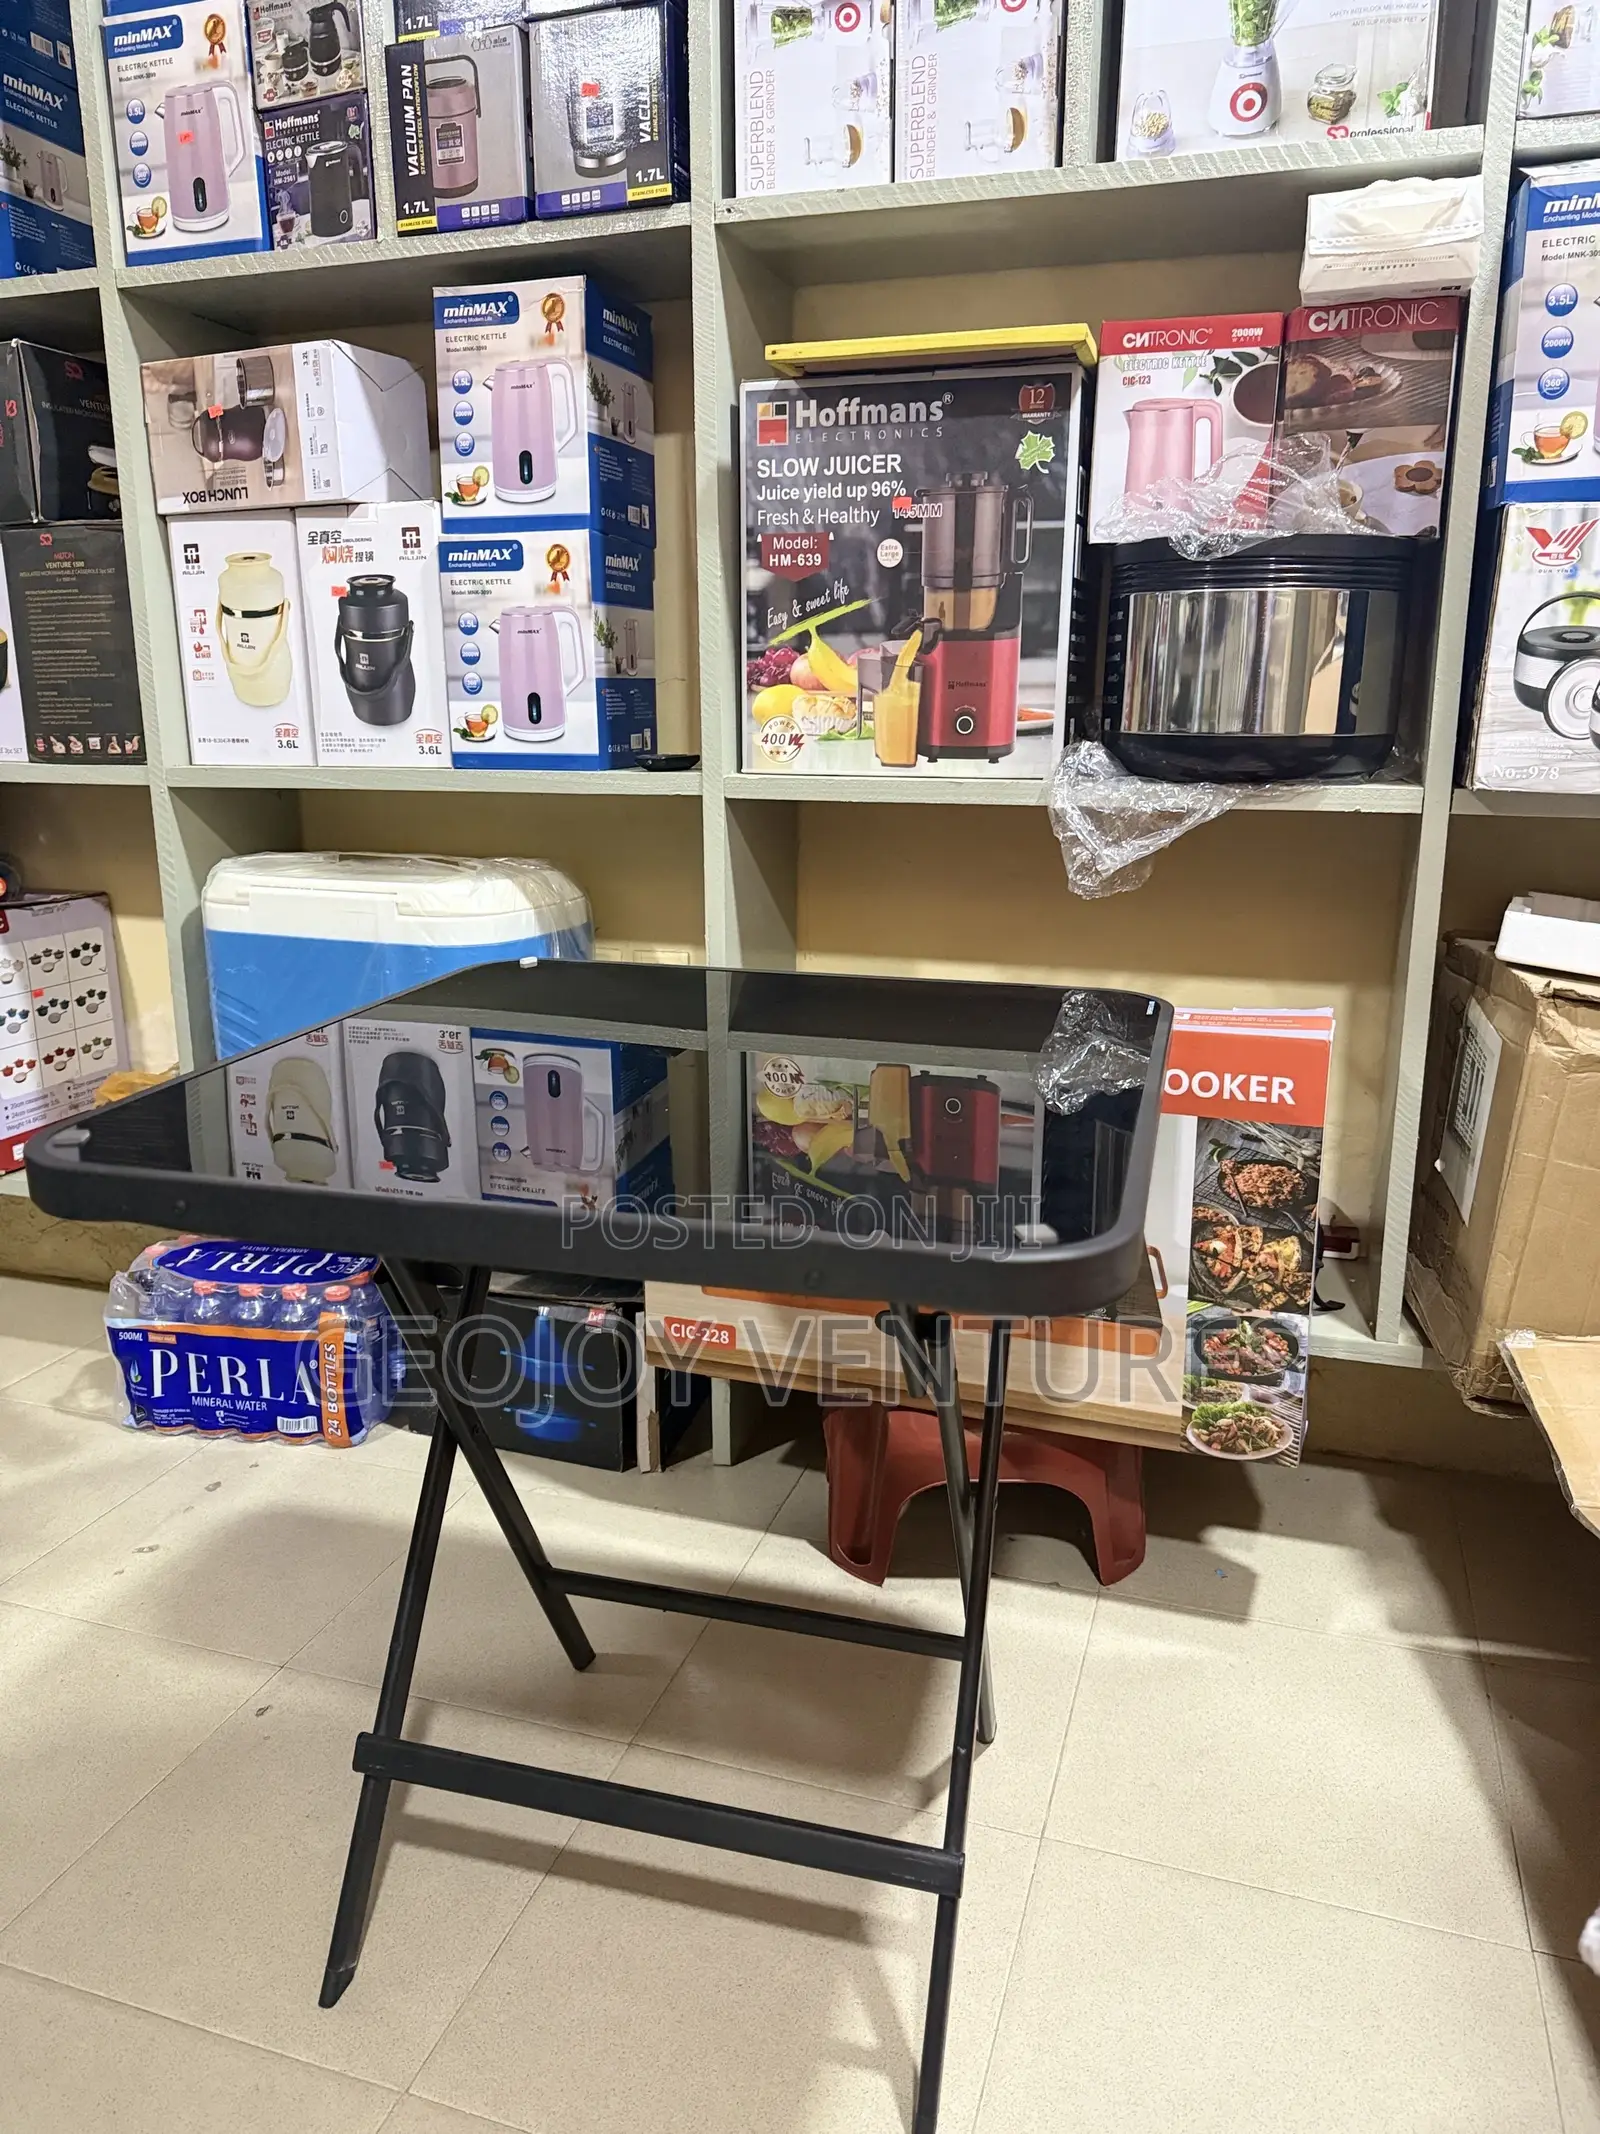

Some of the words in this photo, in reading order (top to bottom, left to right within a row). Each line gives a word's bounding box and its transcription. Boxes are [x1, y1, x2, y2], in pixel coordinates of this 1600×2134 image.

[260, 0, 292, 13] Hoffmans
[405, 15, 432, 30] 1.7L
[1352, 19, 1366, 27] ANTI
[113, 24, 172, 46] minMAX
[117, 61, 148, 72] ELECTRIC
[150, 57, 174, 68] KETTLE
[400, 65, 414, 100] PAN
[927, 52, 938, 105] GRINDER
[3, 73, 63, 112] minMAX
[765, 69, 775, 120] GRINDER
[5, 99, 34, 118] ELECTRIC
[36, 114, 58, 129] KETTLE
[128, 107, 143, 117] 3.5L
[909, 55, 926, 180] SUPERBLEND
[927, 111, 936, 120] &
[274, 114, 319, 131] Hoffmans
[767, 125, 775, 135] &
[750, 71, 765, 191] SUPERBLEND
[265, 136, 296, 151] ELECTRIC
[296, 130, 320, 144] KETTLE
[403, 105, 420, 177] VACUUM
[926, 125, 936, 178] BLENDER
[766, 143, 775, 190] BLENDER
[635, 168, 665, 183] 1.7L
[402, 200, 430, 215] 1.7L
[1543, 213, 1580, 223] Enchanting
[1541, 235, 1596, 249] ELECTRIC
[1548, 294, 1575, 306] 3.5L
[443, 301, 508, 317] minMAX
[602, 308, 639, 337] minMAX
[445, 334, 480, 343] ELECTRIC
[480, 332, 507, 341] KETTLE
[1231, 327, 1264, 338] 2000W
[1543, 337, 1571, 348] 2000W
[1123, 358, 1170, 372] ELECTRIC
[1171, 355, 1207, 369] KETTLE
[454, 377, 471, 387] 3.5L
[1122, 375, 1151, 386] CIC-123
[1029, 388, 1045, 405] 12
[795, 397, 944, 428] Hoffmans
[1022, 411, 1051, 419] WARRANTY
[795, 426, 943, 444] ELECTRONICS
[757, 457, 819, 478] SLOW
[823, 454, 902, 475] JUICER
[182, 491, 207, 504] BOX
[208, 487, 248, 502] LUNCH
[756, 485, 799, 502] Juice
[803, 483, 843, 503] yield
[846, 486, 867, 501] up
[871, 480, 907, 497] 96%
[757, 507, 799, 526] Fresh
[802, 510, 815, 525] &
[818, 505, 880, 527] Healthy
[307, 530, 342, 545] 全真空
[772, 536, 818, 551] Model:
[448, 547, 512, 562] minMAX
[769, 553, 822, 568] HM-639
[45, 561, 72, 569] VENTURE
[605, 553, 639, 572] minMAX
[767, 607, 788, 630] Easy
[792, 599, 803, 618] &
[806, 588, 831, 612] sweet
[834, 578, 850, 604] life
[460, 620, 477, 628] 3.5L
[769, 720, 796, 731] POWER
[275, 728, 299, 739] 全真空
[415, 733, 444, 744] 全真空
[277, 739, 299, 750] 3.6L
[418, 745, 443, 756] 3.6L
[1164, 1068, 1297, 1105] OOKER
[271, 1245, 310, 1254] MINERAL
[176, 1248, 332, 1277] PERLA
[119, 1331, 143, 1341] 500ML
[670, 1322, 729, 1345] CIC-228
[149, 1348, 319, 1407] PERLA
[324, 1342, 339, 1413] BOTTLES
[191, 1396, 234, 1411] MINERAL
[235, 1399, 268, 1412] WATER
[327, 1419, 342, 1437] 24
